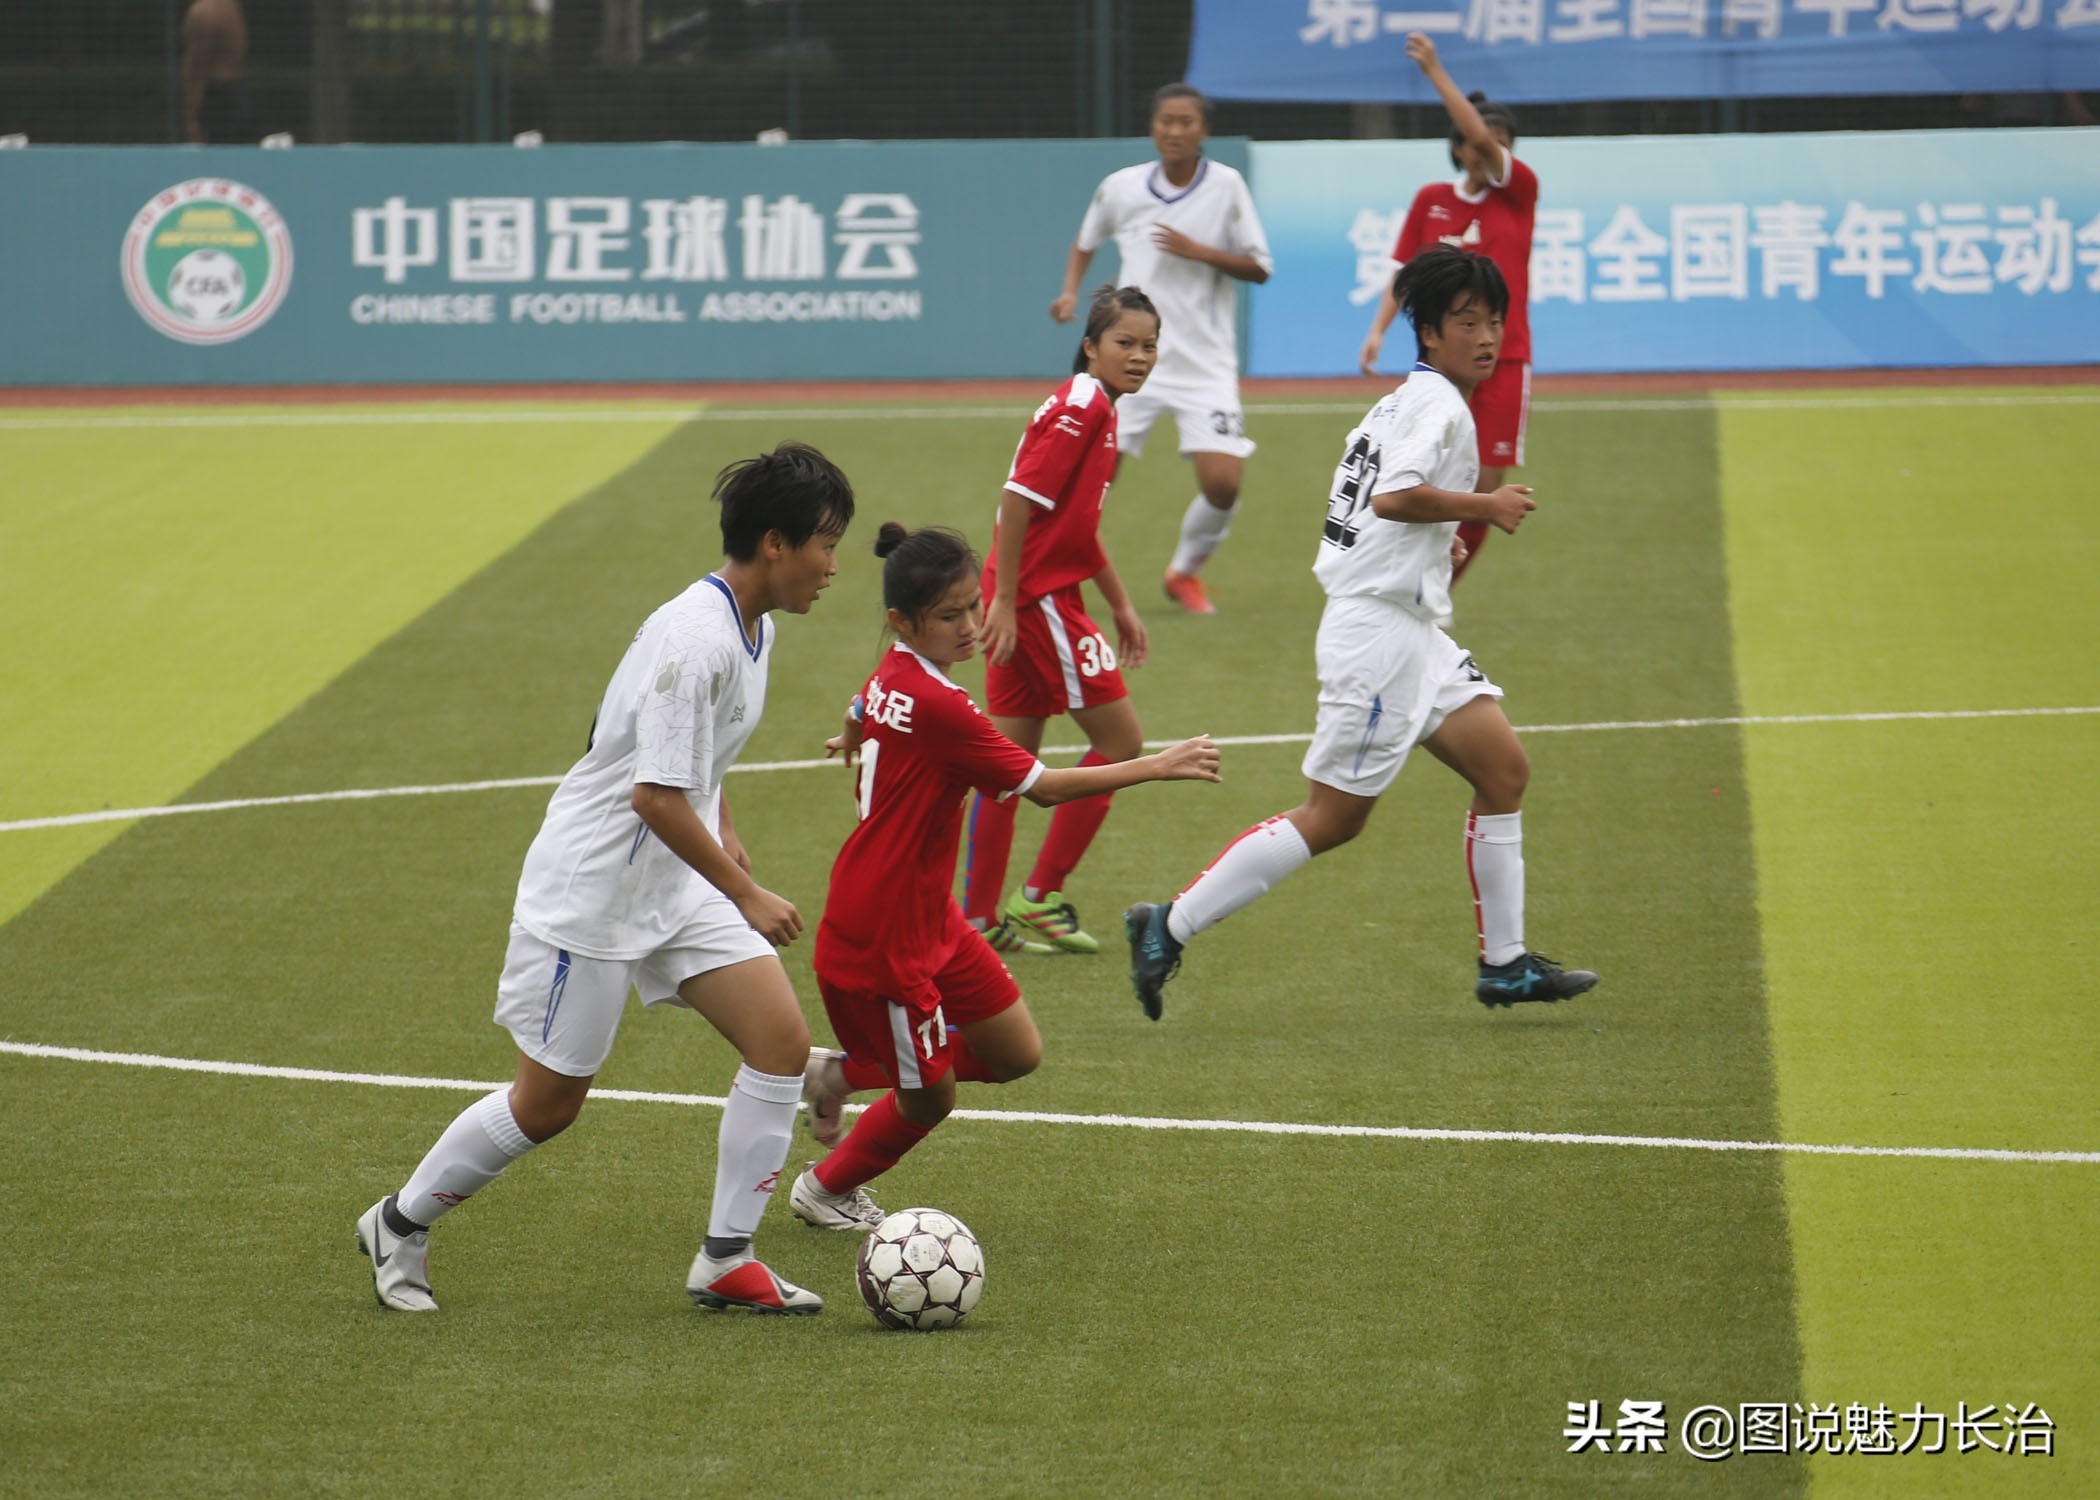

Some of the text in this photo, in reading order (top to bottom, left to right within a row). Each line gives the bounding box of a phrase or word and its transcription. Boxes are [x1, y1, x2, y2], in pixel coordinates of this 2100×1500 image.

[352, 193, 922, 283] 中国足球协会
[1347, 196, 2100, 307] 第届全国青年运动
[352, 289, 922, 323] CHINESE FOOTBALL ASSOCIATION
[1077, 632, 1117, 678] 36
[917, 1004, 948, 1060] 11
